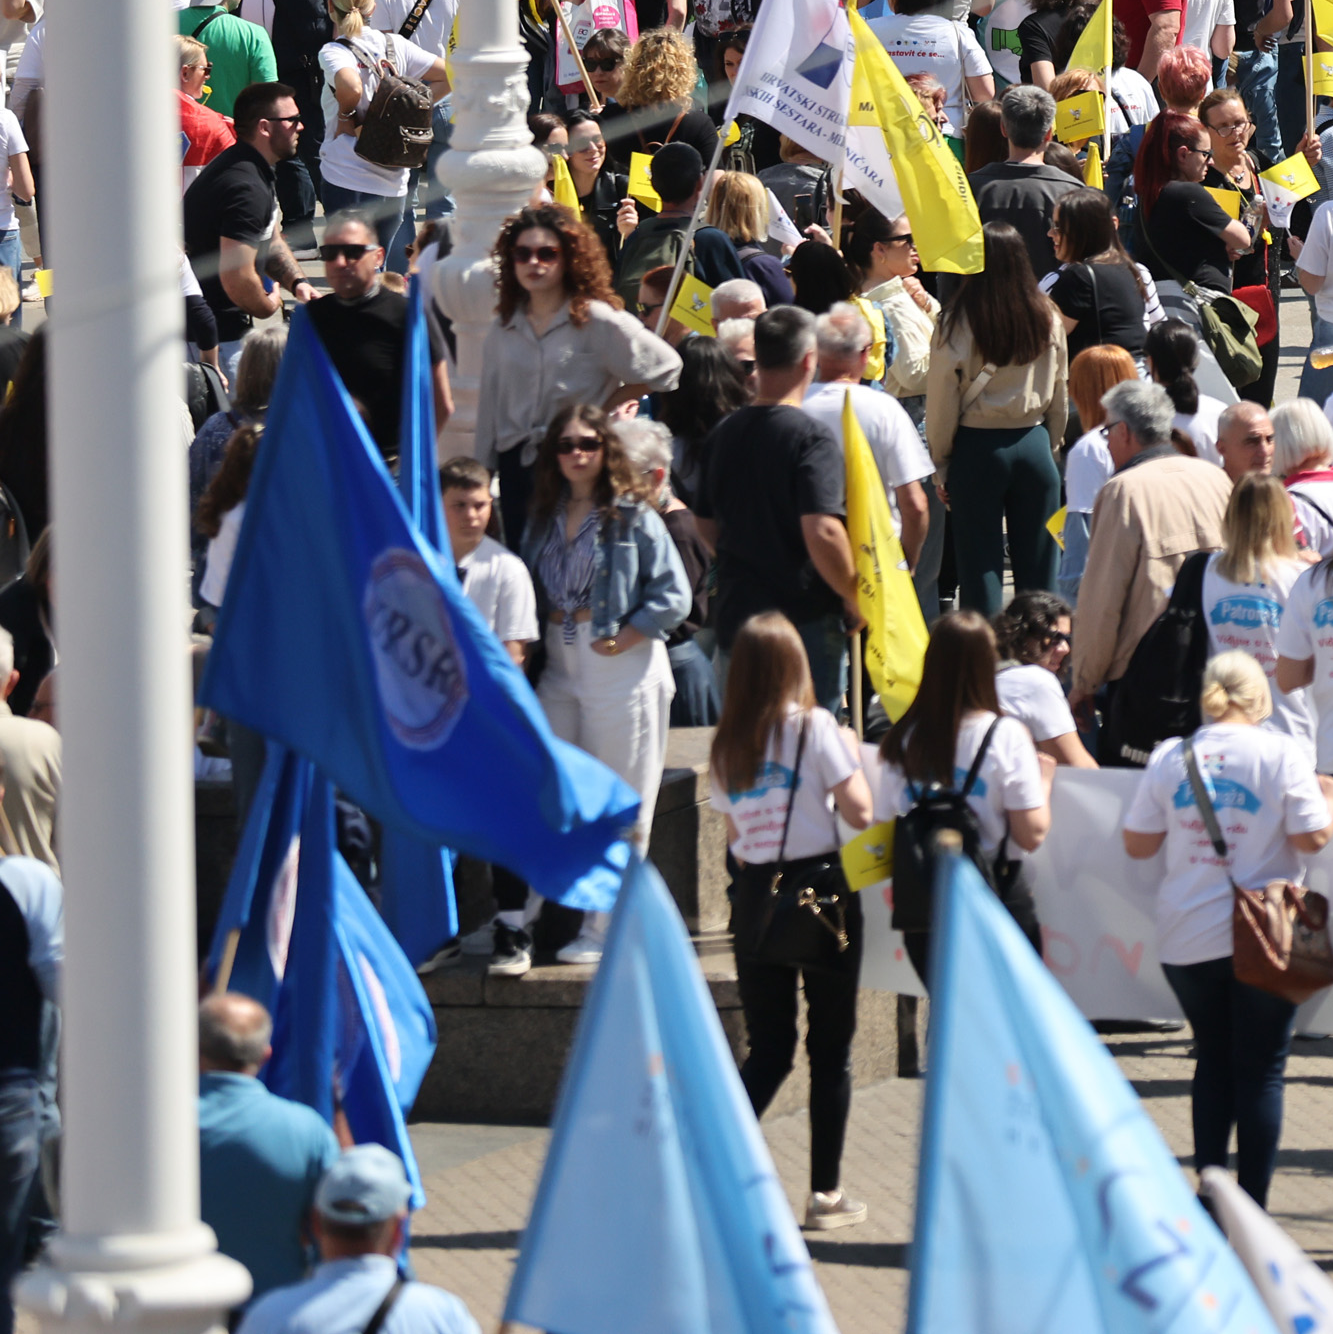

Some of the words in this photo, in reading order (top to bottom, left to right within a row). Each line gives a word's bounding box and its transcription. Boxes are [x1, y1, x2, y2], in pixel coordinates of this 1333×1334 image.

[916, 48, 928, 59] će
[759, 72, 817, 113] HRVATSKI
[773, 99, 822, 138] SESTARA
